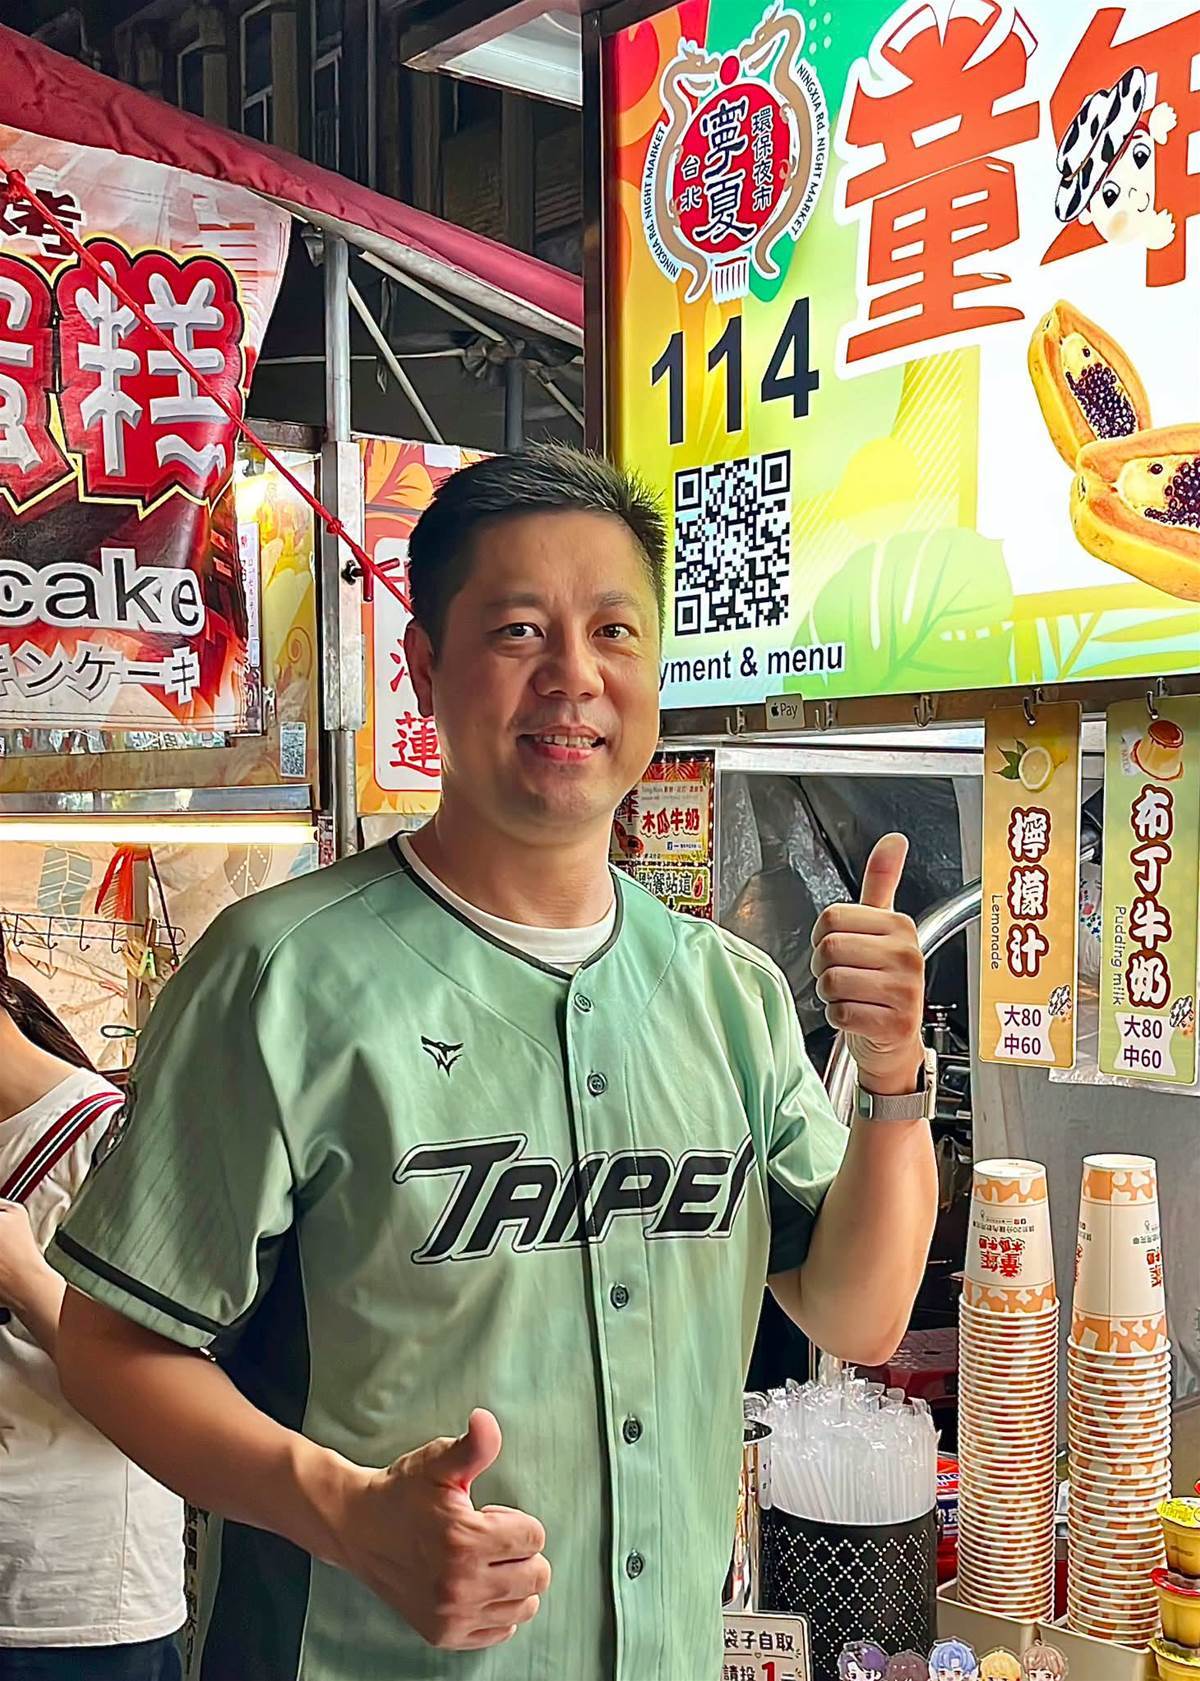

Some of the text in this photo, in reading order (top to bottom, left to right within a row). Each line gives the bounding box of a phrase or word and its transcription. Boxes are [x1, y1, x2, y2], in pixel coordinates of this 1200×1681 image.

[680, 155, 701, 211] 台北
[694, 96, 755, 242] 寧夏
[752, 107, 773, 210] 環保夜市
[791, 64, 825, 236] NINGXIA Rd. NIGHT MARKET
[643, 126, 679, 278] NINGXIA Rd. NIGHT MARKET
[651, 297, 820, 446] 114
[740, 646, 758, 677] &
[767, 644, 844, 675] menu
[780, 703, 798, 717] Pay
[642, 807, 700, 835] 木瓜牛奶
[1008, 808, 1051, 976] 檸檬汁
[1128, 786, 1173, 1007] 布丁牛奶
[991, 894, 1003, 970] Lemonade
[1111, 906, 1126, 1005] Pudding milk
[1004, 1005, 1042, 1028] 大80
[1004, 1036, 1041, 1056] 中60
[1123, 1015, 1163, 1040] 大80
[1123, 1045, 1162, 1070] 中60
[392, 1133, 757, 1265] TAIPEI
[724, 1629, 794, 1651] 袋子自取
